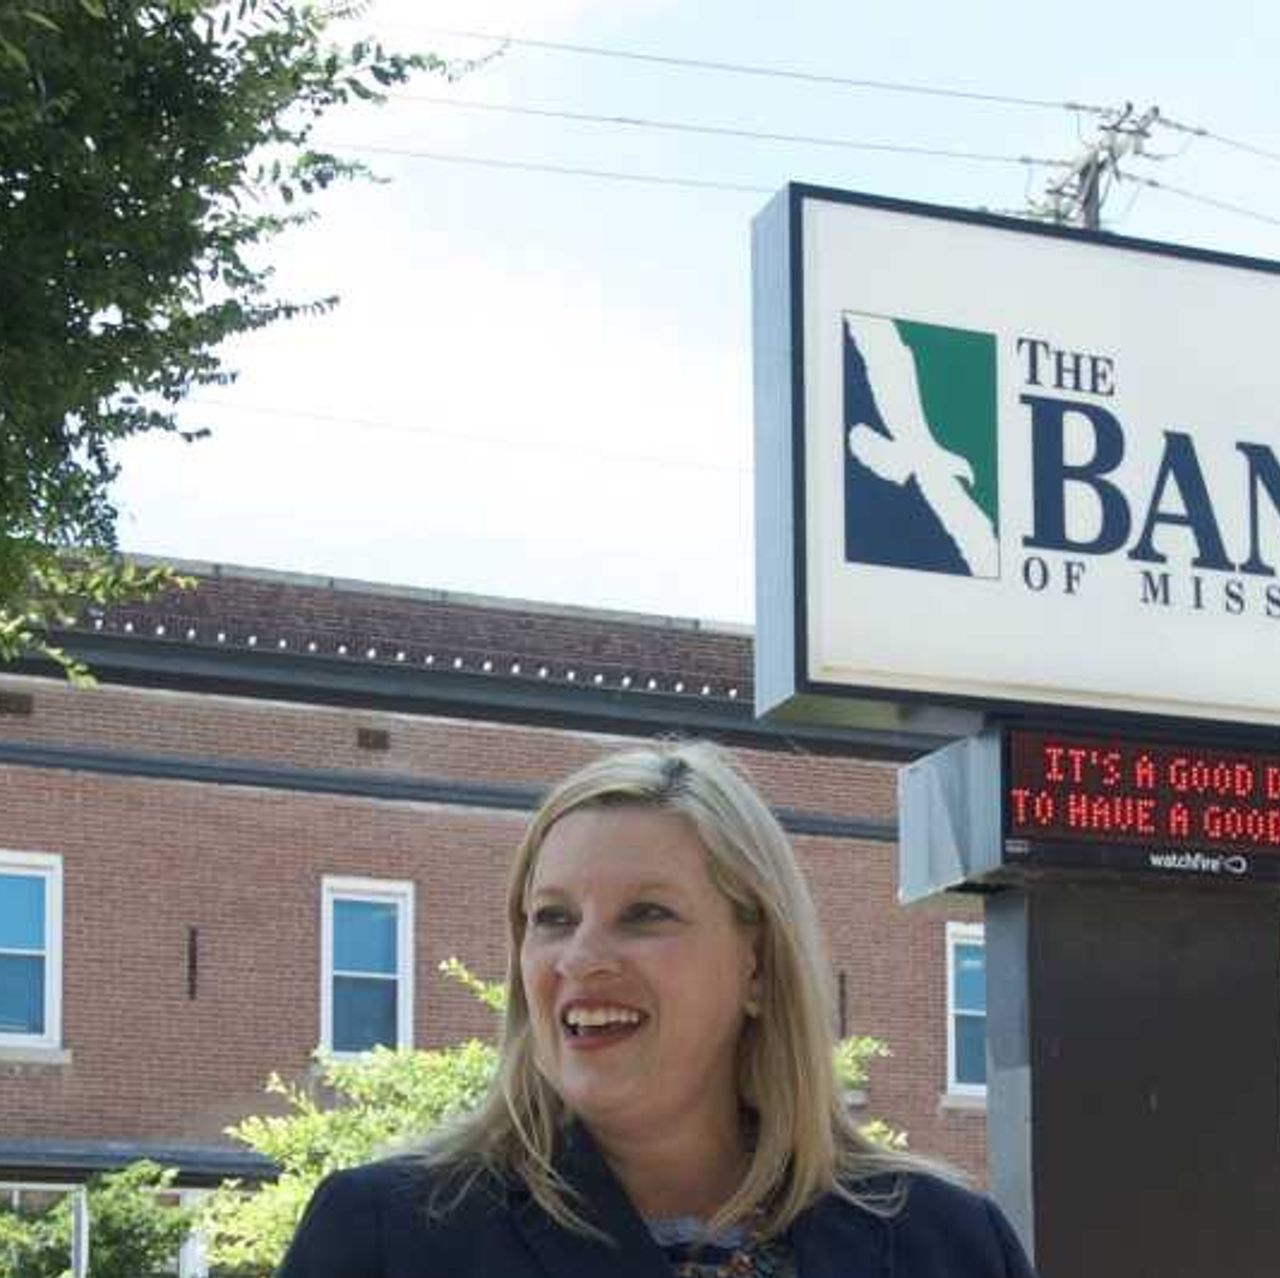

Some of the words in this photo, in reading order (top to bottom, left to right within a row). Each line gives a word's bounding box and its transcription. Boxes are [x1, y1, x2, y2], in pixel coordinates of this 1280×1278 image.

[1017, 337, 1116, 397] THE
[1023, 556, 1086, 595] OF
[1044, 748, 1120, 786] IT'S
[1136, 755, 1155, 789] A
[1169, 758, 1253, 797] GOOD
[1011, 788, 1054, 826] TO
[1070, 794, 1156, 833] HAVE
[1170, 803, 1189, 837] A
[1149, 851, 1220, 873] watchfire
